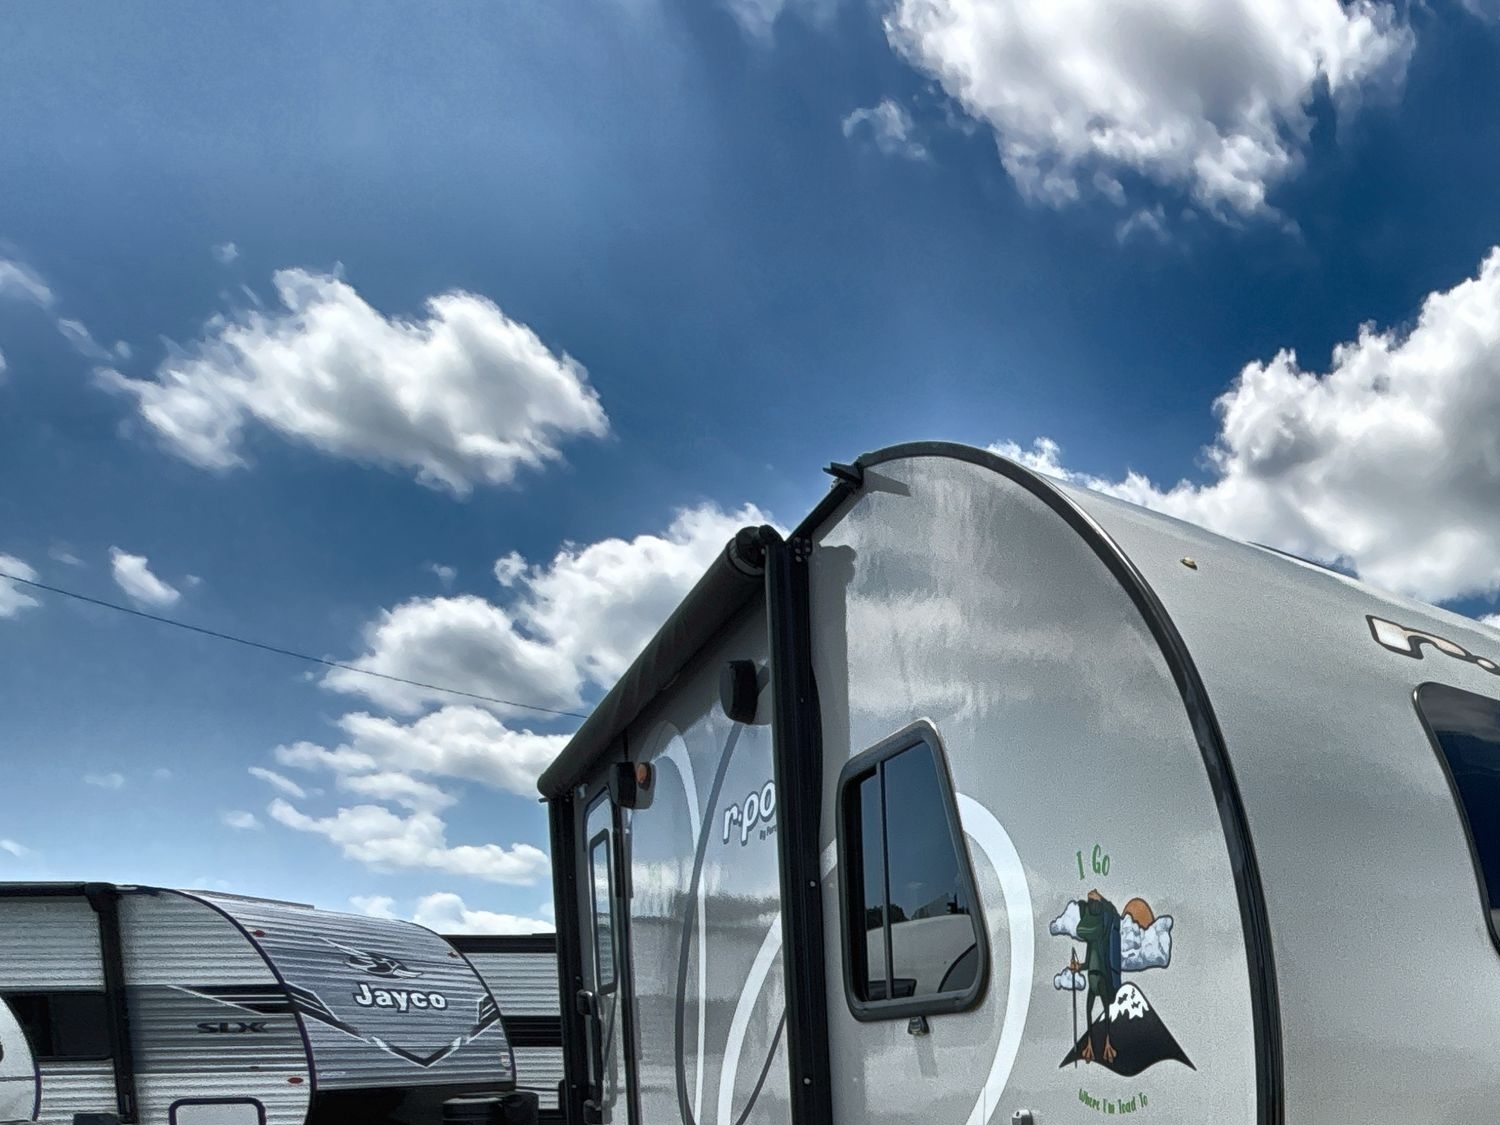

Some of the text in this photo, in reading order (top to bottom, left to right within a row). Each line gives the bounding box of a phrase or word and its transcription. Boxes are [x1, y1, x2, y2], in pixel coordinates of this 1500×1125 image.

[1076, 850, 1085, 880] I
[353, 981, 448, 1013] Jayco
[197, 1021, 268, 1033] SLX
[1079, 1088, 1100, 1111] Where
[1138, 1092, 1148, 1108] To
